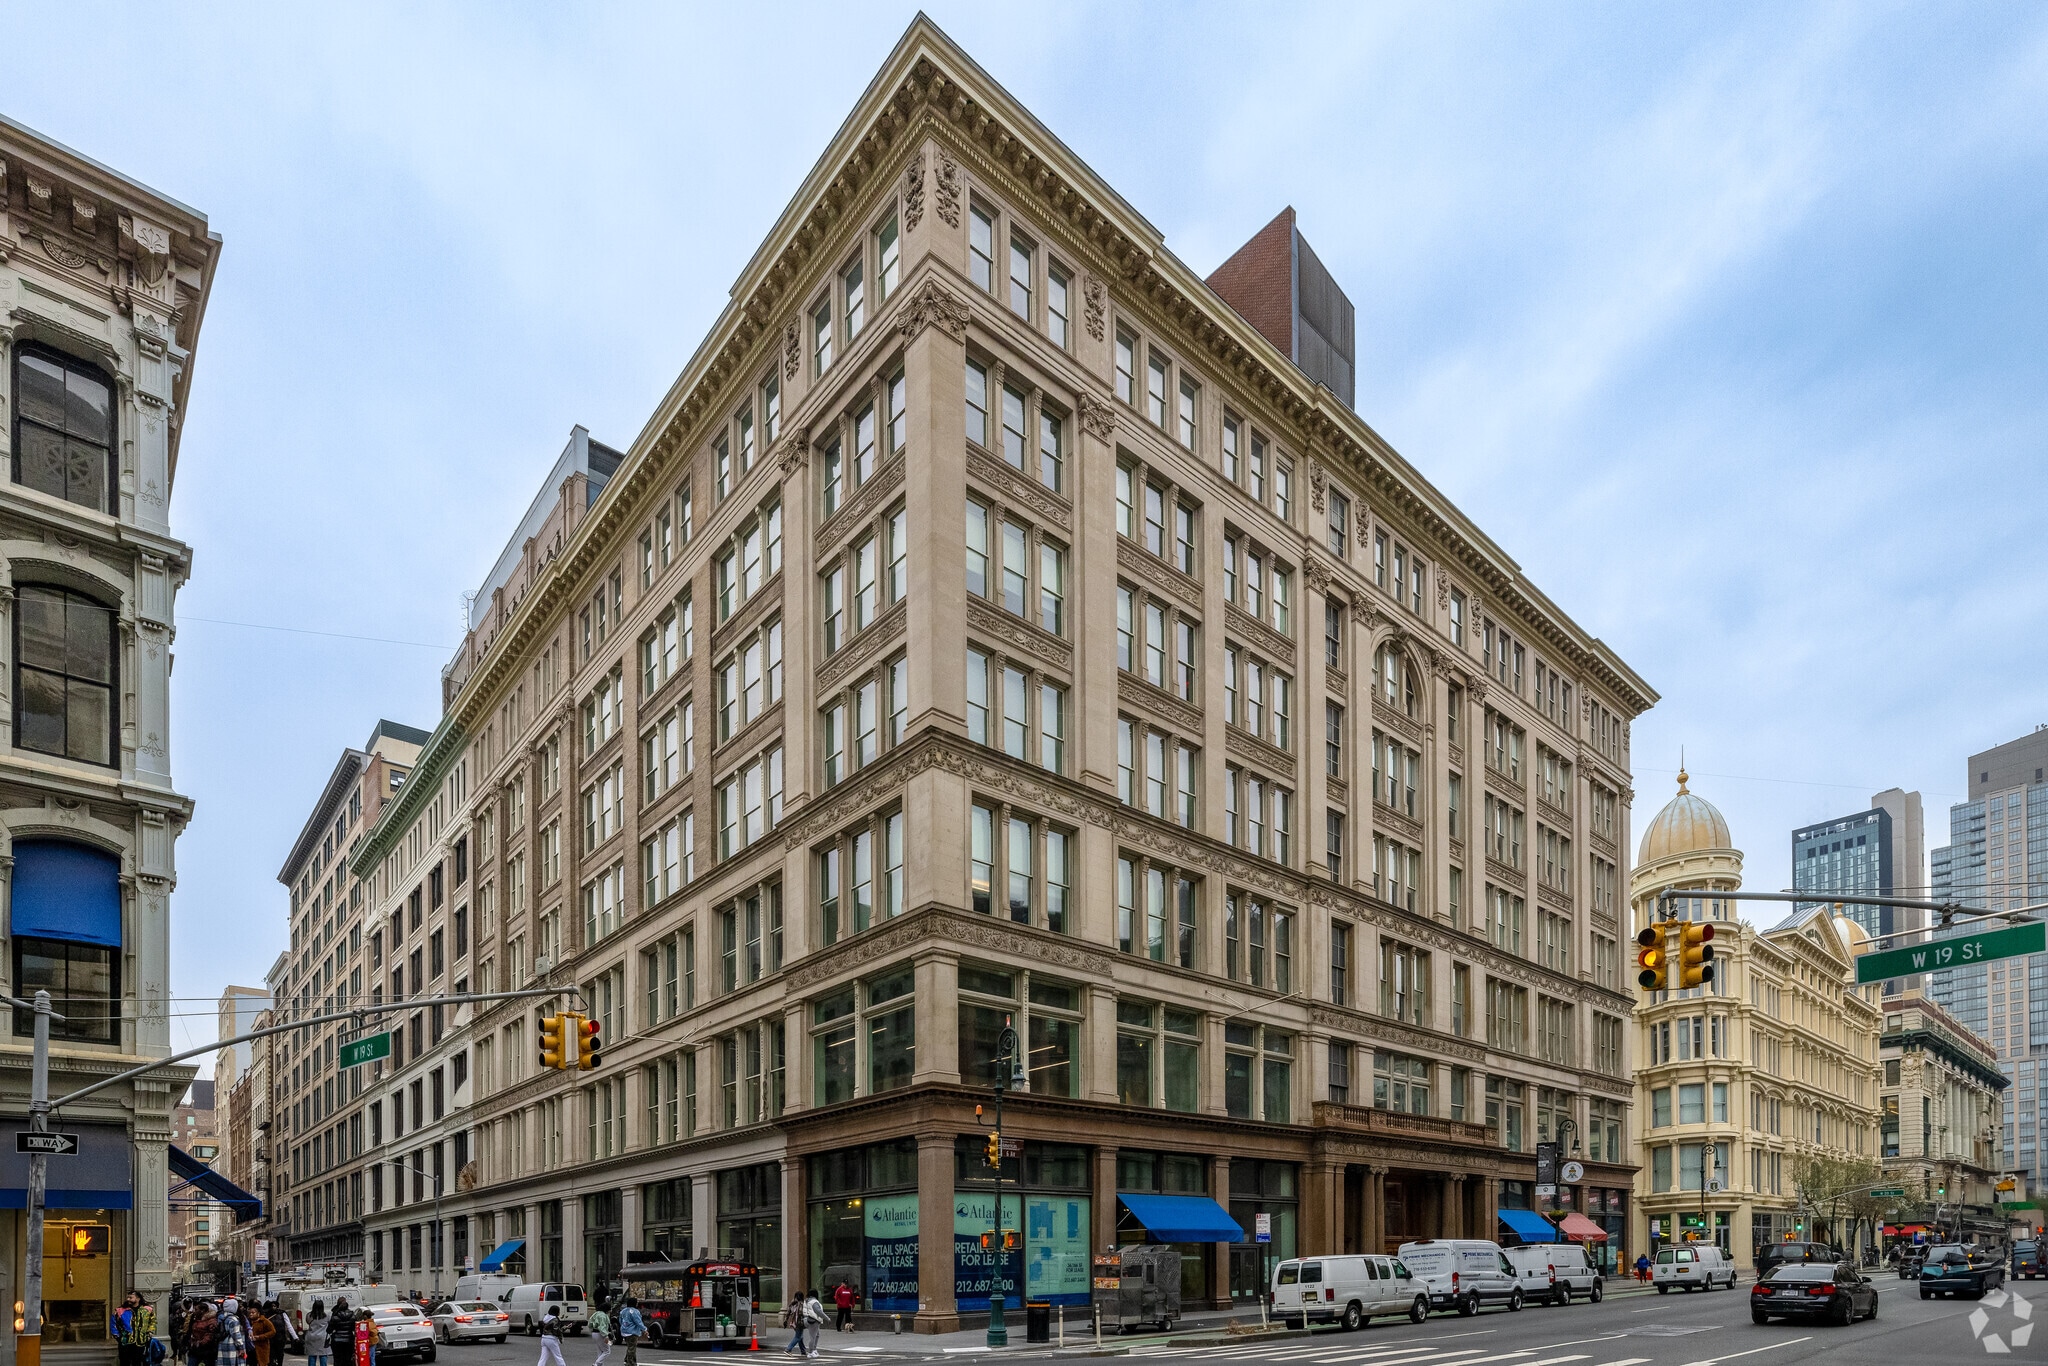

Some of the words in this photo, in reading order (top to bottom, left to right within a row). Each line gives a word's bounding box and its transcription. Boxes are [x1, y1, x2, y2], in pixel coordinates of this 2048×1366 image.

[1912, 951, 1927, 968] W
[1934, 946, 1953, 964] 19
[1962, 941, 1983, 960] St
[354, 1047, 359, 1060] W
[360, 1045, 366, 1060] 19
[366, 1043, 374, 1057] St
[42, 1138, 66, 1148] WAY
[882, 1206, 918, 1222] Atlantic
[970, 1204, 1013, 1220] Atlaic
[872, 1244, 894, 1256] RETAIL
[894, 1242, 918, 1256] SPACE
[876, 1256, 891, 1268] FOR
[892, 1256, 914, 1268] LEASE
[961, 1254, 980, 1266] FOR
[873, 1281, 918, 1294] 212.687.2400
[956, 1279, 1014, 1293] 212.687.00
